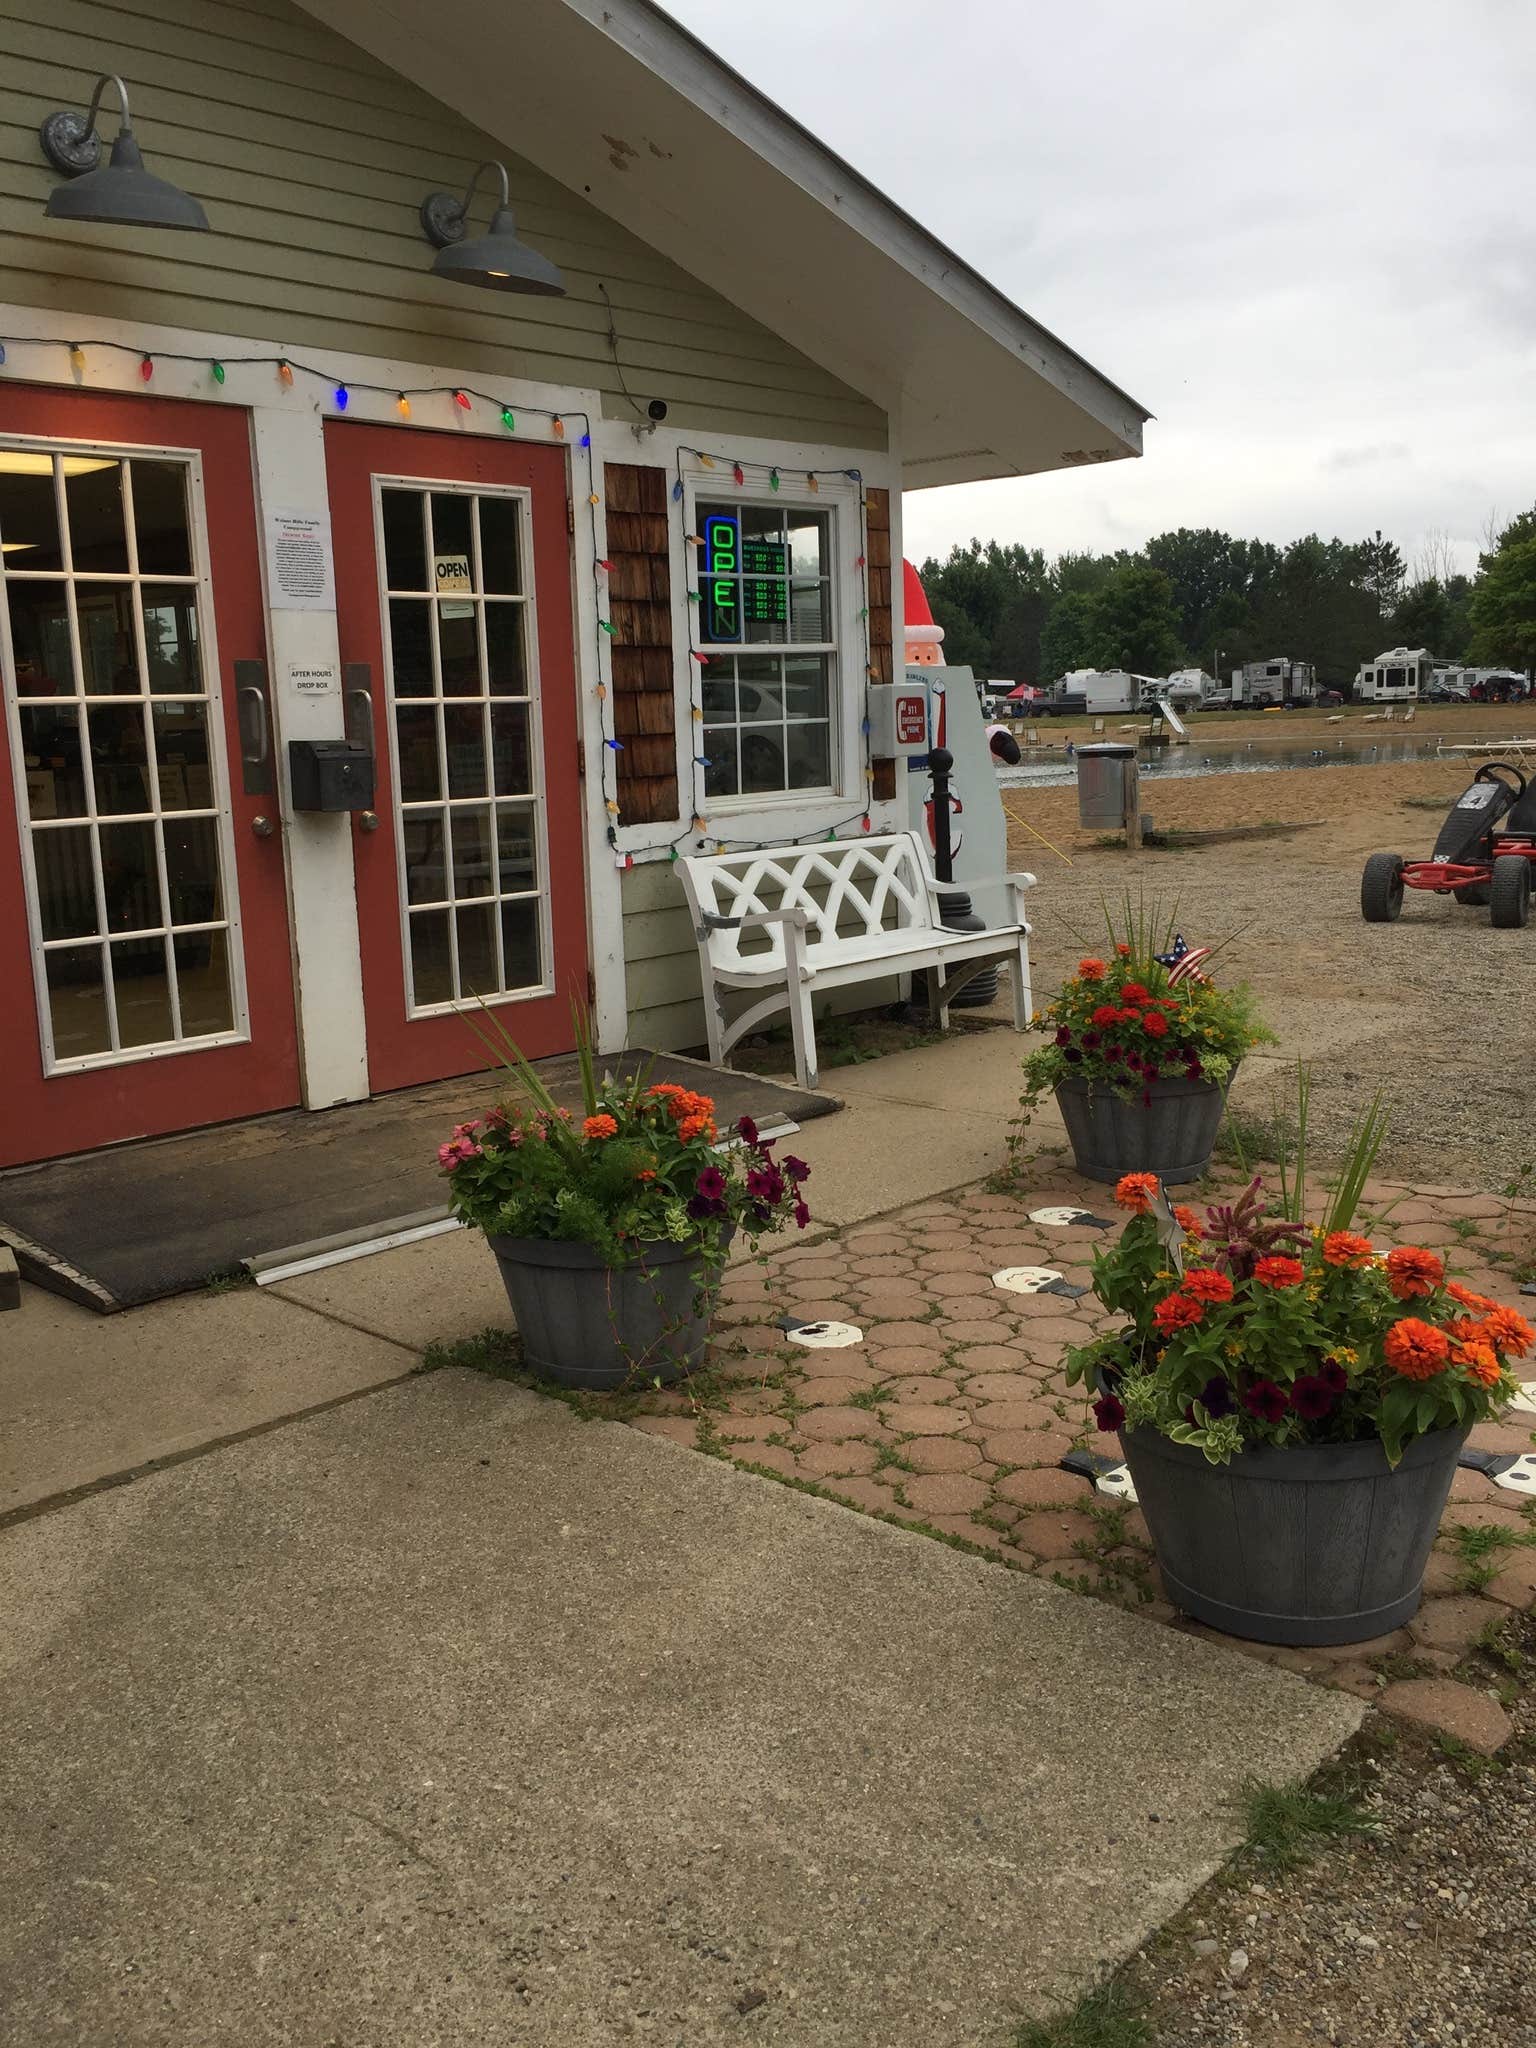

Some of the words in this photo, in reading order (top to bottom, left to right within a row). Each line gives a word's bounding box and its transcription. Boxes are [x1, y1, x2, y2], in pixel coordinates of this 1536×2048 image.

[437, 562, 468, 578] OPEN
[713, 525, 735, 635] OPEN
[907, 705, 917, 715] 911
[1469, 796, 1483, 806] 4
